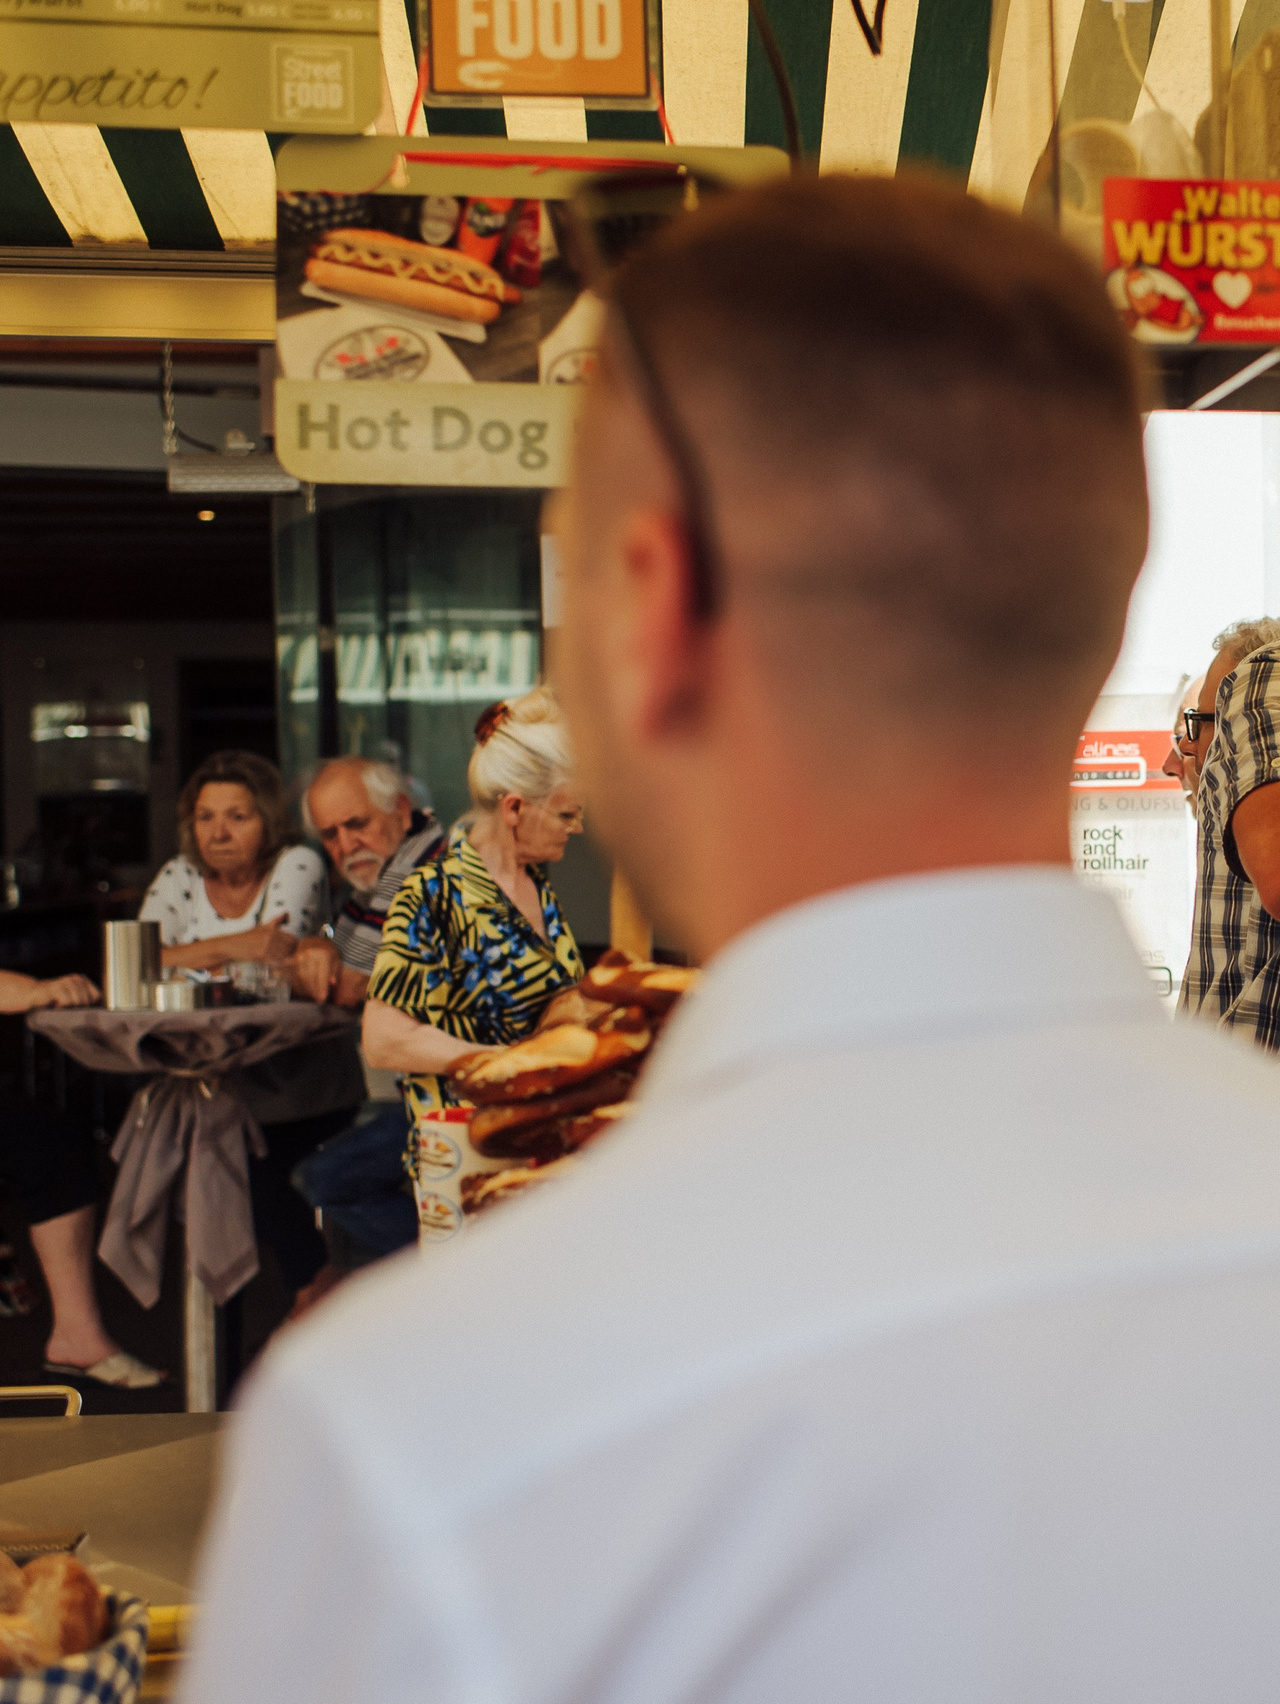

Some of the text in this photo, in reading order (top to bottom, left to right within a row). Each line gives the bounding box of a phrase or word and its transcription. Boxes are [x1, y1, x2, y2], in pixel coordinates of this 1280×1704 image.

[456, 0, 622, 60] FOOD
[0, 65, 220, 119] ppetito!
[297, 403, 550, 471] Hot Dog
[1098, 797, 1108, 810] &
[1083, 825, 1123, 840] rock
[1083, 842, 1116, 856] and
[1083, 854, 1149, 870] rollhair
